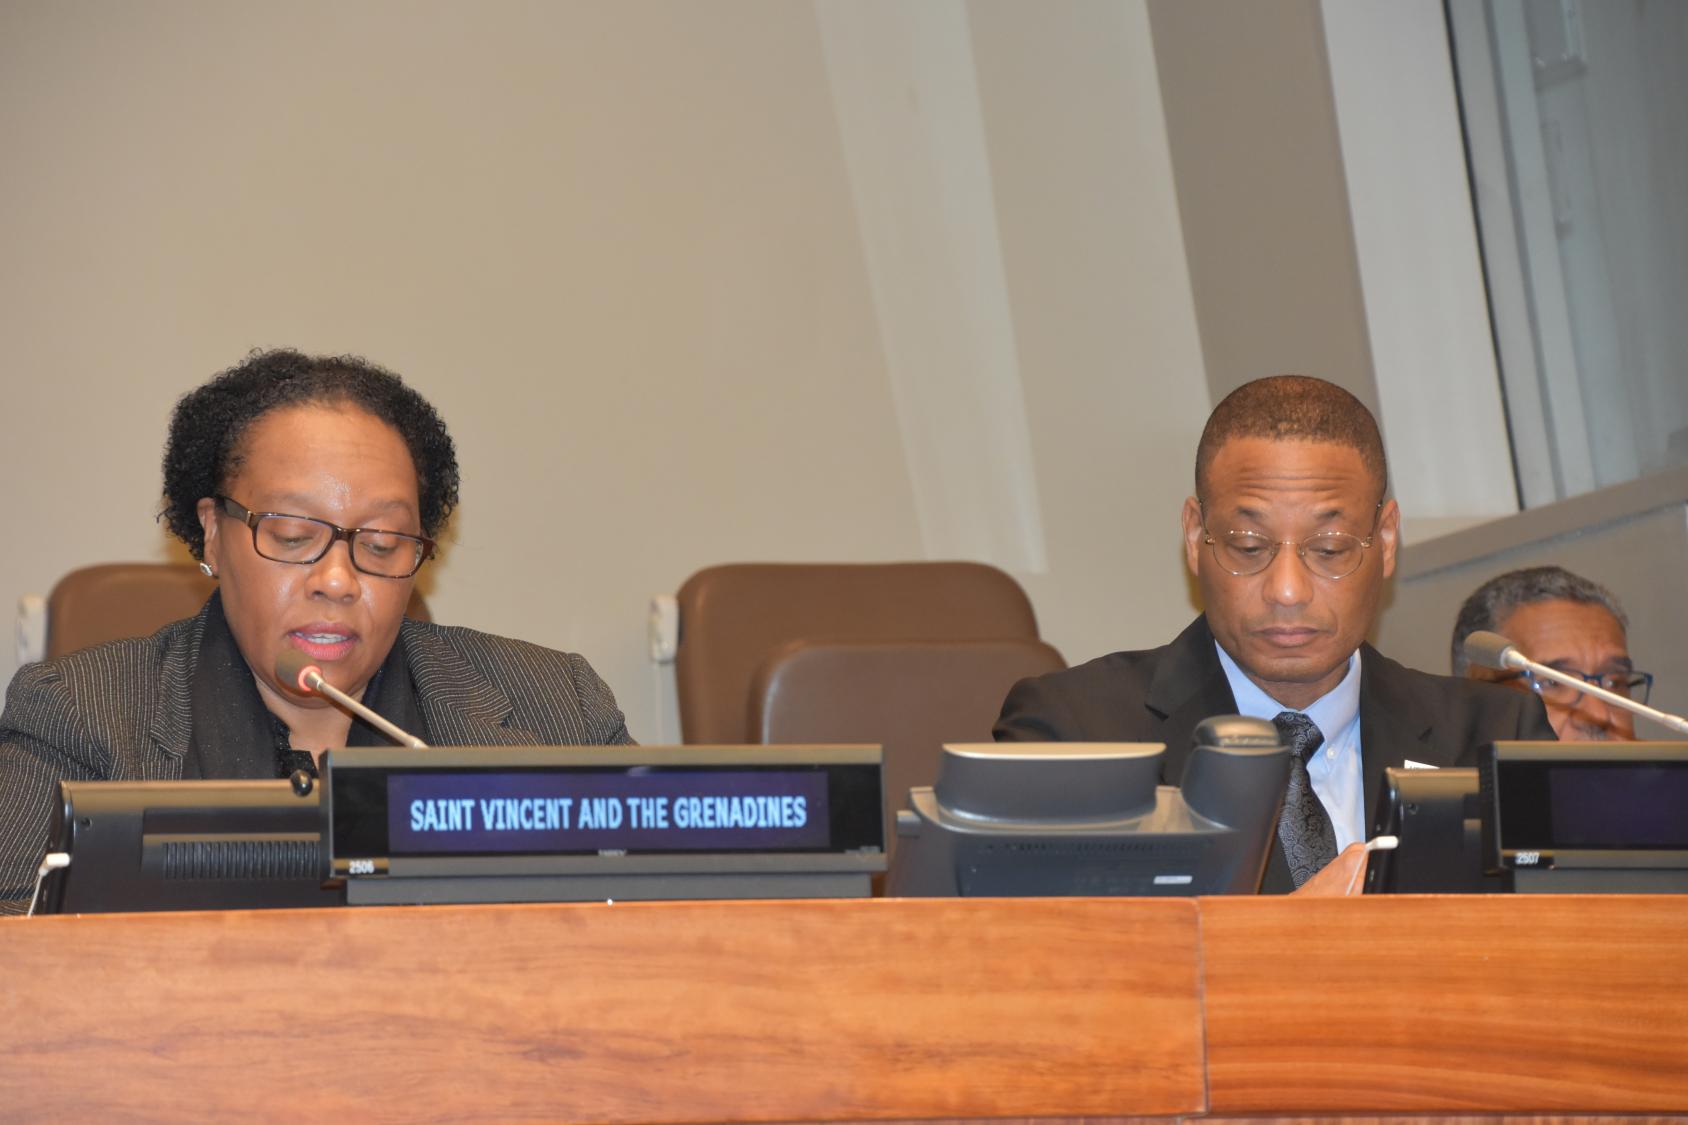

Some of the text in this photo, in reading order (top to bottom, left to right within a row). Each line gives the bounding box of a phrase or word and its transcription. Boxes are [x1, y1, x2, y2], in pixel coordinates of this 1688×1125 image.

[410, 796, 807, 831] SAINT VINCENT AND THE GRENADINES
[1515, 850, 1540, 865] 2507
